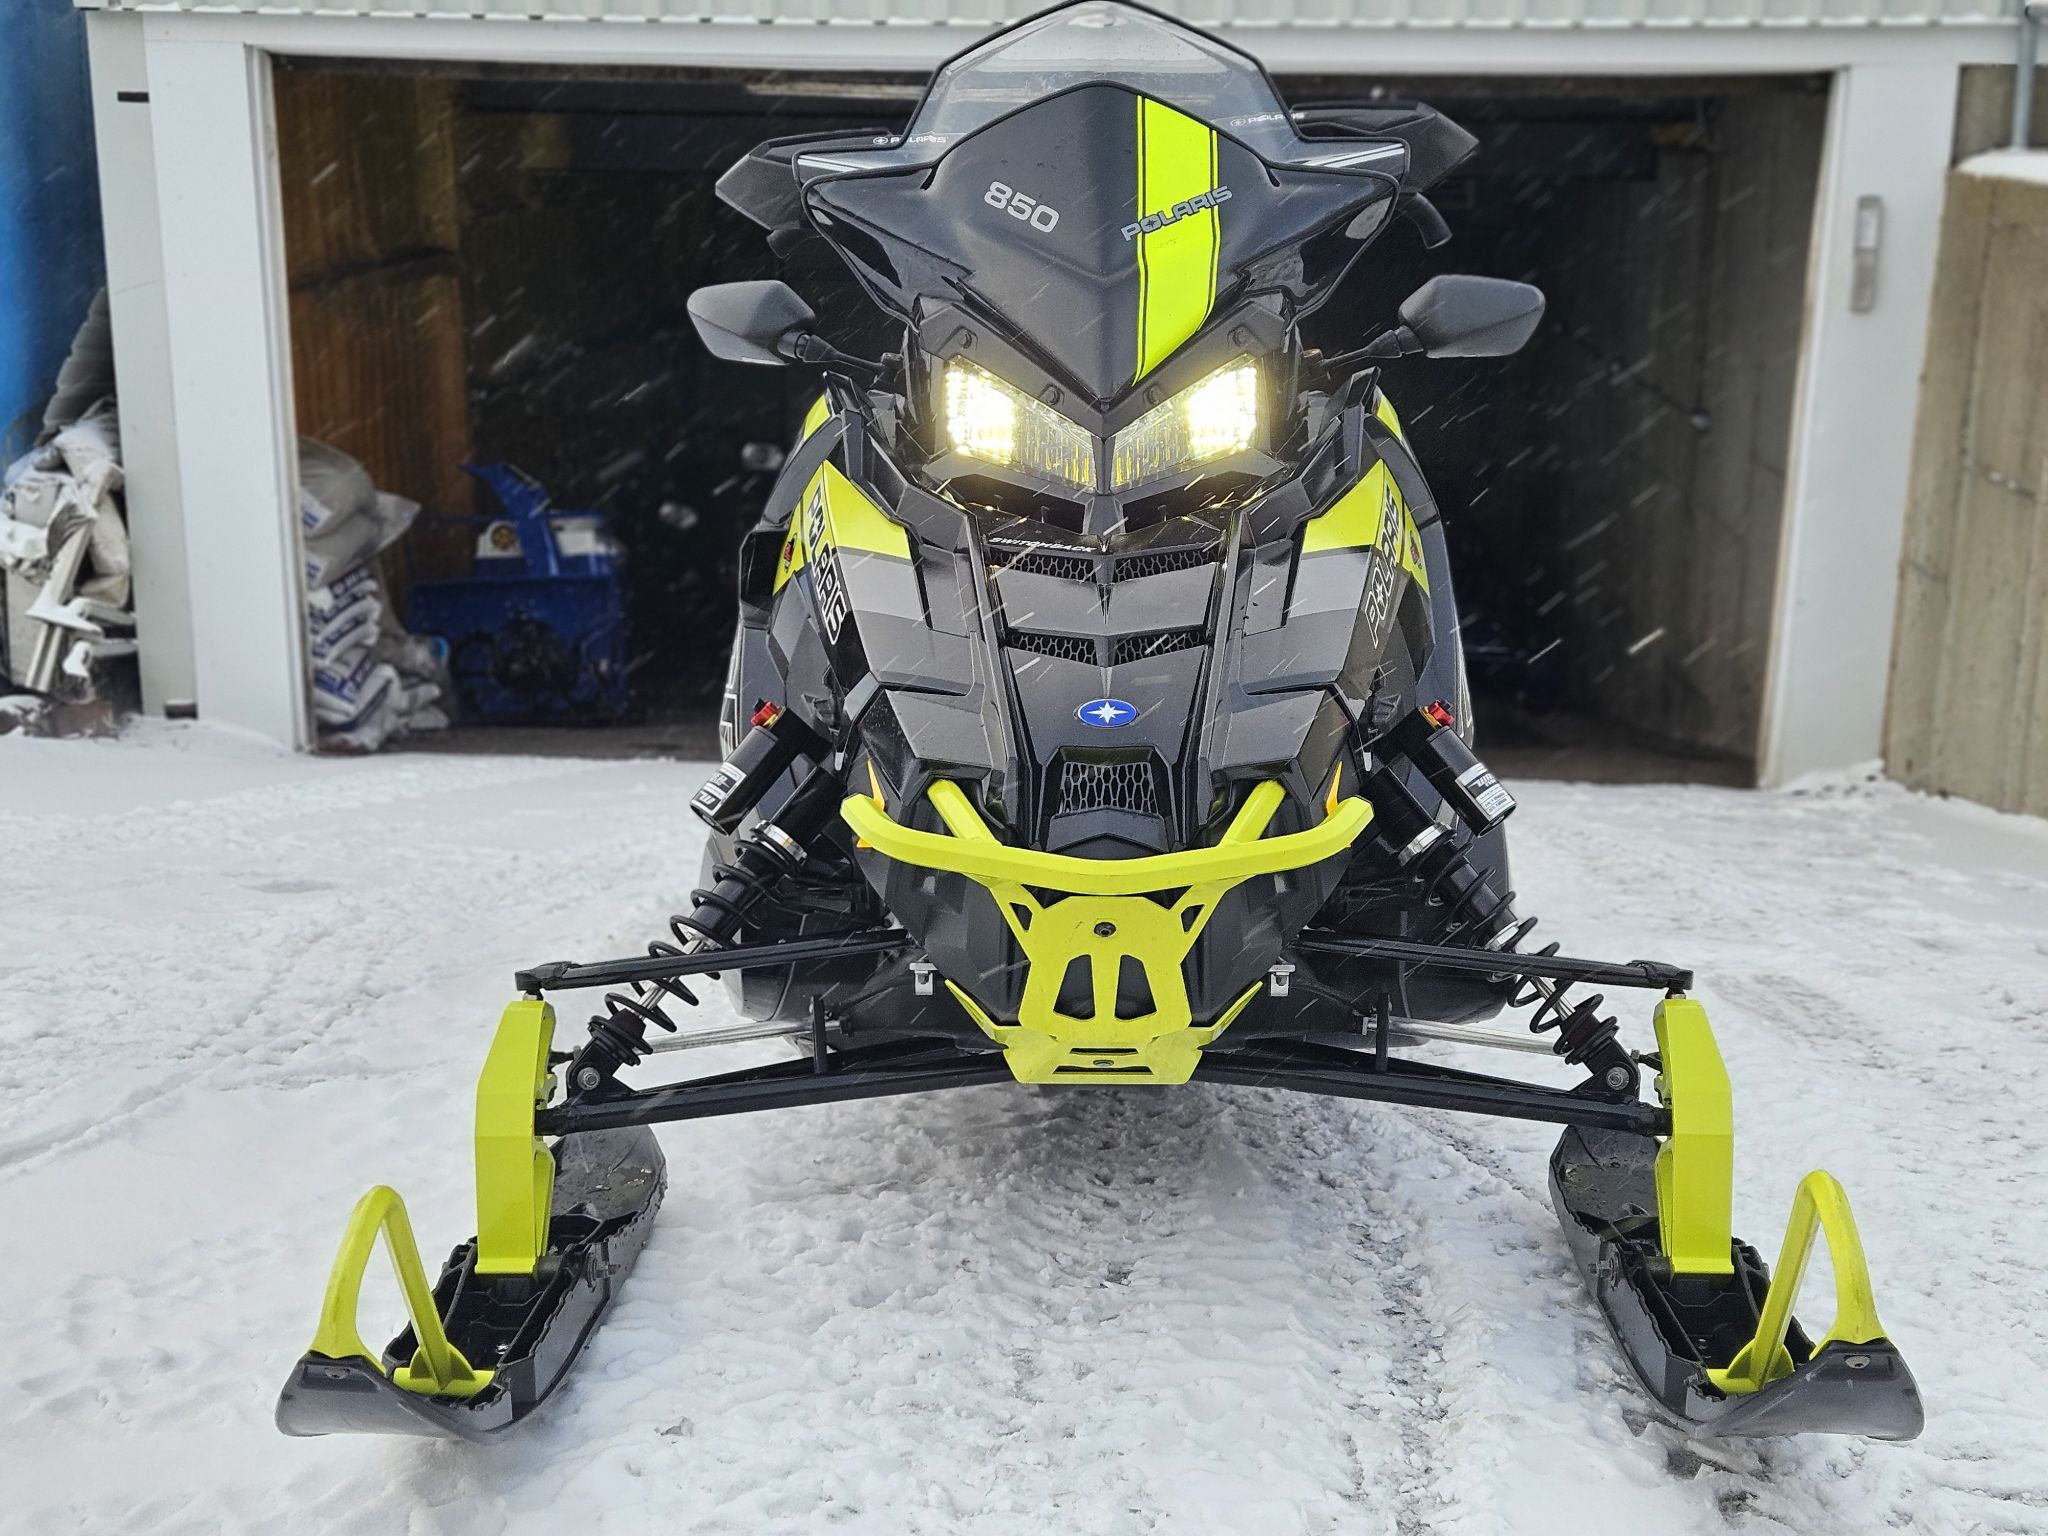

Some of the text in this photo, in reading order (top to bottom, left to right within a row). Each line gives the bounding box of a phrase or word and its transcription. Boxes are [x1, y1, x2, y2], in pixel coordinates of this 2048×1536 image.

[889, 135, 947, 144] PLARS
[1247, 112, 1305, 124] POLAIS
[983, 181, 1060, 233] 850
[1120, 185, 1233, 242] POLARIS
[807, 480, 848, 646] POLARIS
[1364, 479, 1401, 650] POLARIS
